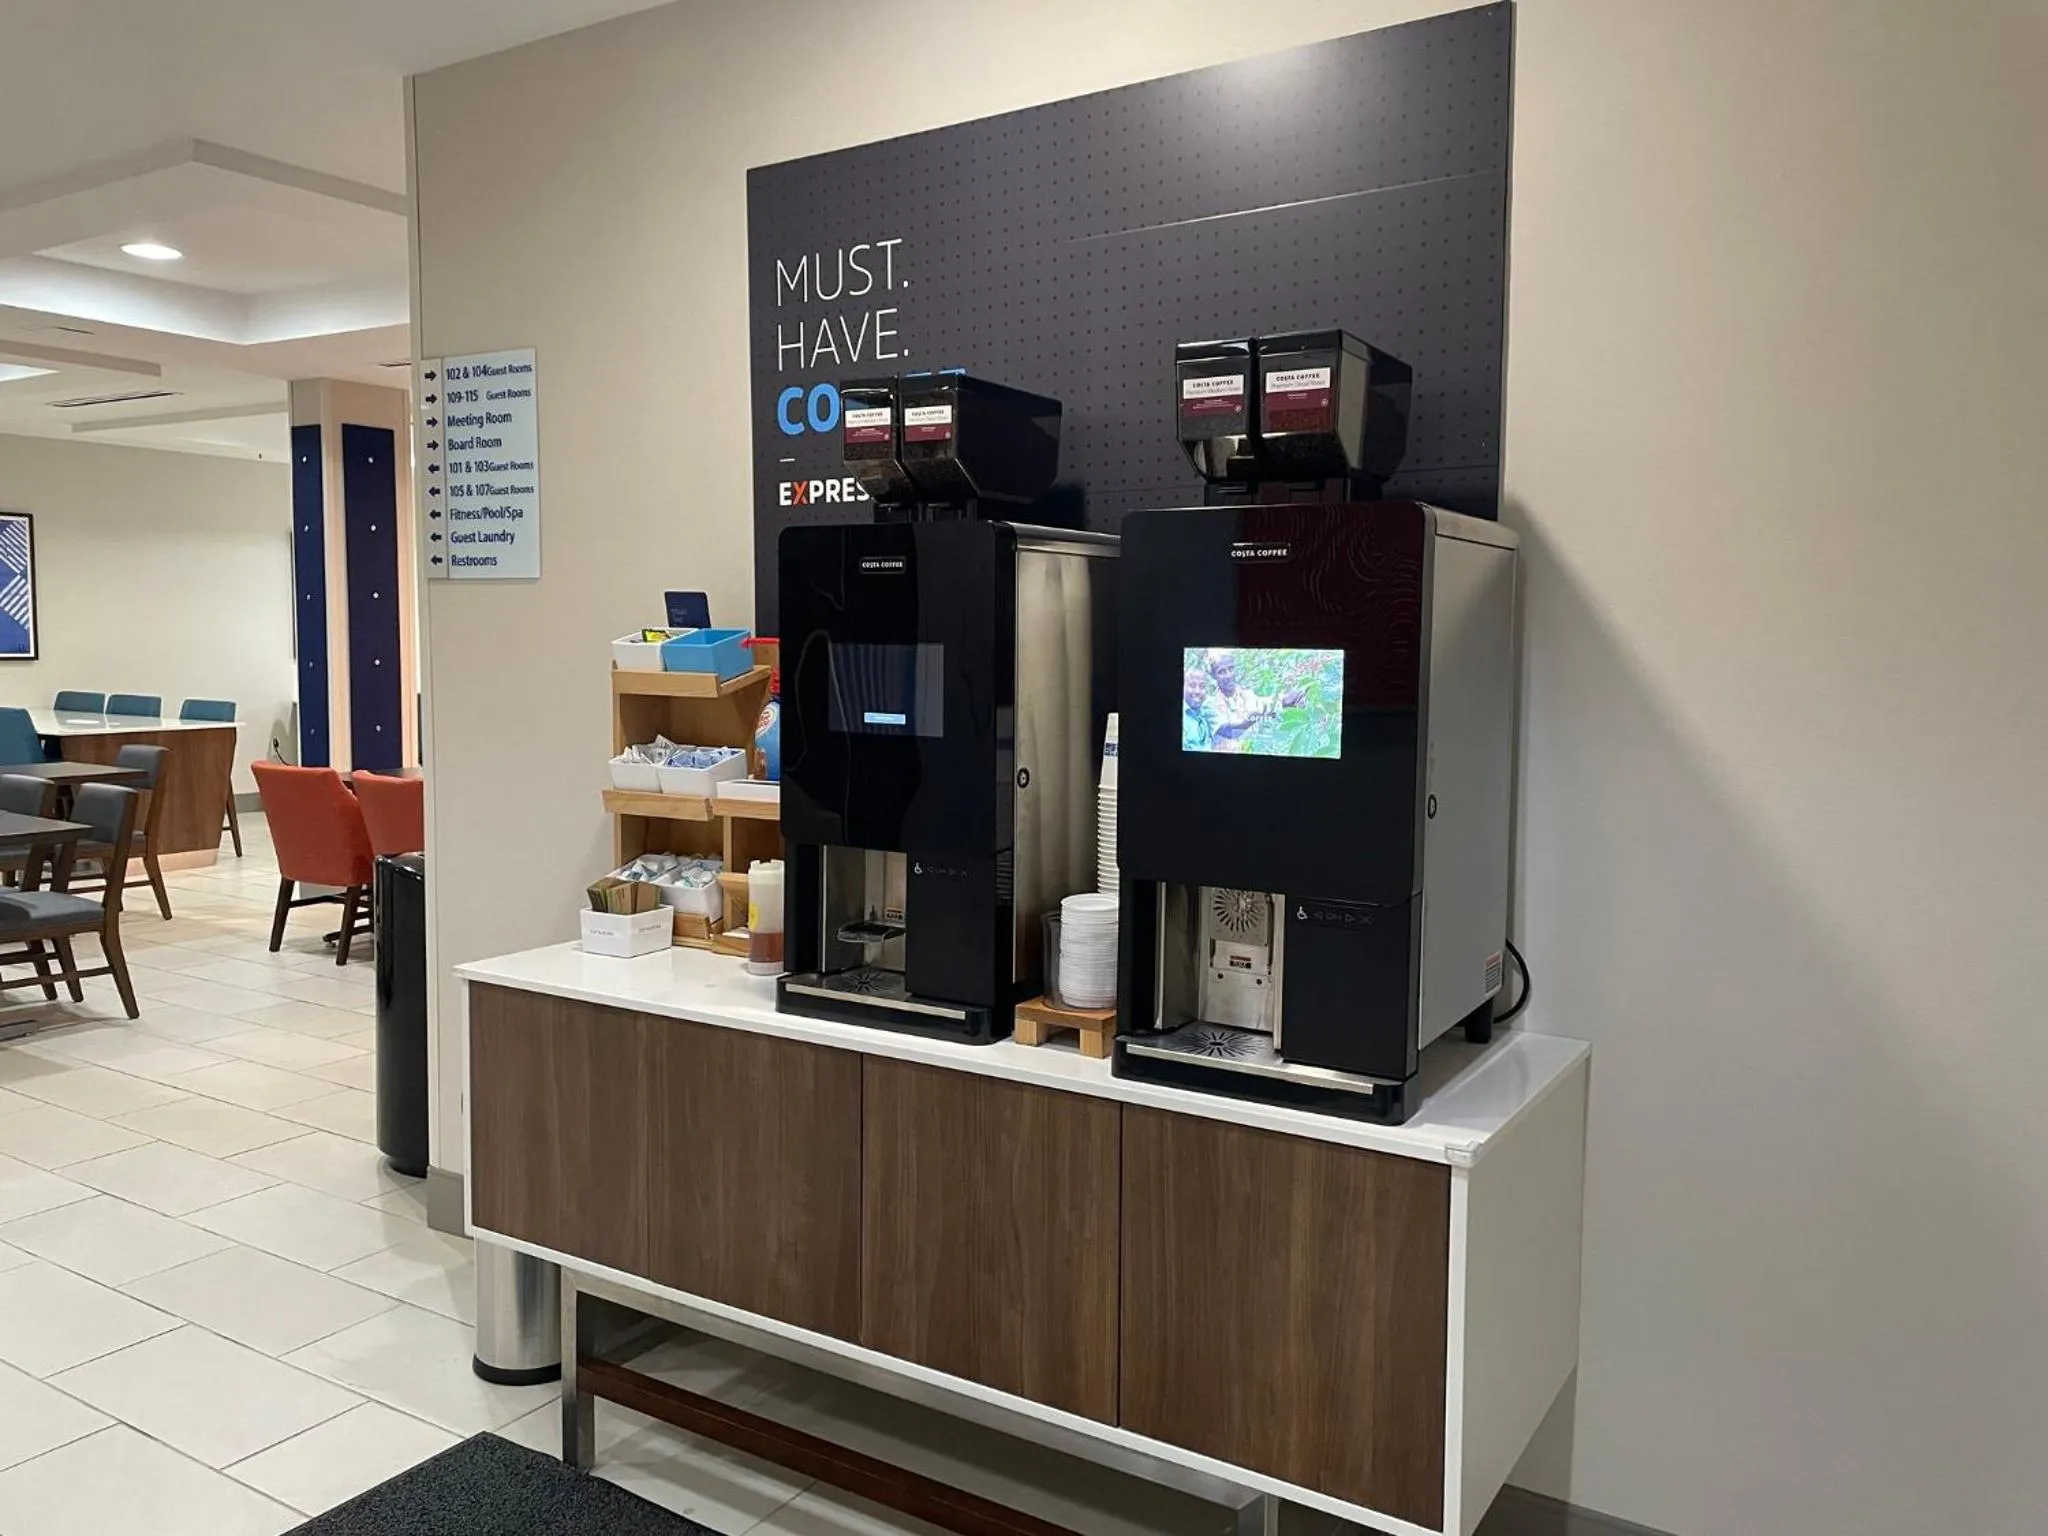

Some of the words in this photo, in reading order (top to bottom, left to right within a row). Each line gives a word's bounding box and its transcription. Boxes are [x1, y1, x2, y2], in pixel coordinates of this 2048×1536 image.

[776, 238, 909, 307] MUST.
[777, 307, 909, 372] HAVE.
[446, 367, 461, 380] 102
[462, 366, 469, 379] &
[472, 364, 486, 377] 104
[486, 366, 507, 376] Guest
[508, 364, 532, 374] Rooms
[447, 389, 478, 404] 109-115
[485, 390, 506, 400] Guest
[507, 388, 531, 399] Rooms
[447, 413, 484, 428] Meeting
[485, 411, 512, 424] Room
[447, 436, 474, 451] Board
[475, 436, 502, 449] Room
[449, 462, 463, 473] 101
[465, 461, 472, 473] &
[474, 460, 489, 472] 103
[489, 462, 509, 471] Guest
[510, 461, 534, 470] Rooms
[450, 485, 464, 497] 105
[466, 484, 473, 496] &
[475, 483, 490, 496] 107
[489, 486, 509, 495] Guest
[510, 484, 534, 494] Rooms
[779, 477, 870, 507] EXPRES
[449, 506, 524, 521] Fitness/Pool/Spa
[451, 531, 476, 544] Guest
[477, 529, 515, 545] Laundry
[451, 554, 498, 566] Restrooms
[1231, 550, 1255, 558] COSTA
[1256, 548, 1288, 557] COFFEE
